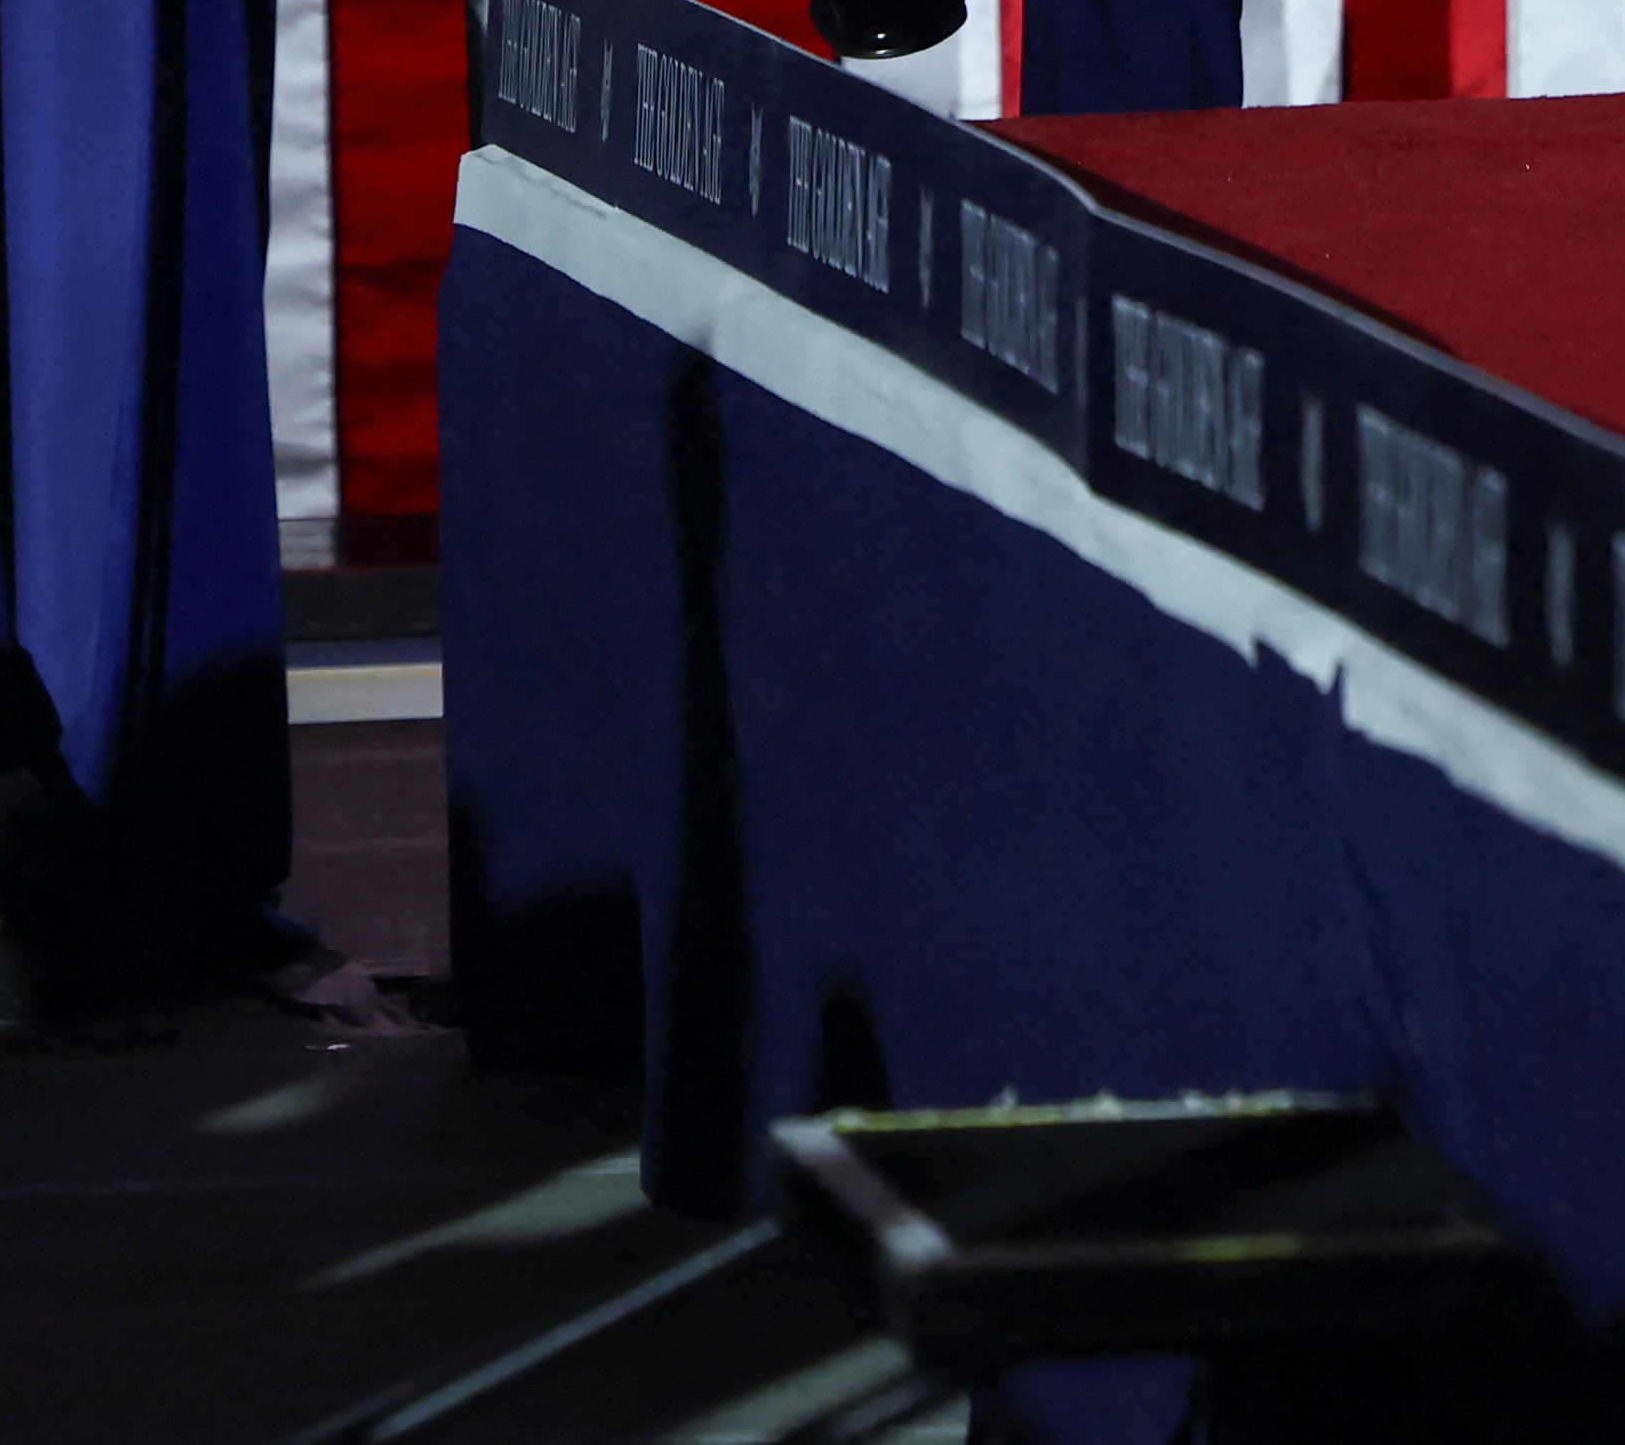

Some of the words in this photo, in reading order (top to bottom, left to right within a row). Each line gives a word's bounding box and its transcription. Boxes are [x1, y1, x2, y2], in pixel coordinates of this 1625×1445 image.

[633, 42, 658, 172] THE
[655, 53, 703, 193] GOLDEN
[699, 75, 725, 206] AGE
[786, 114, 812, 255] THE
[810, 126, 866, 280] GOLDEN
